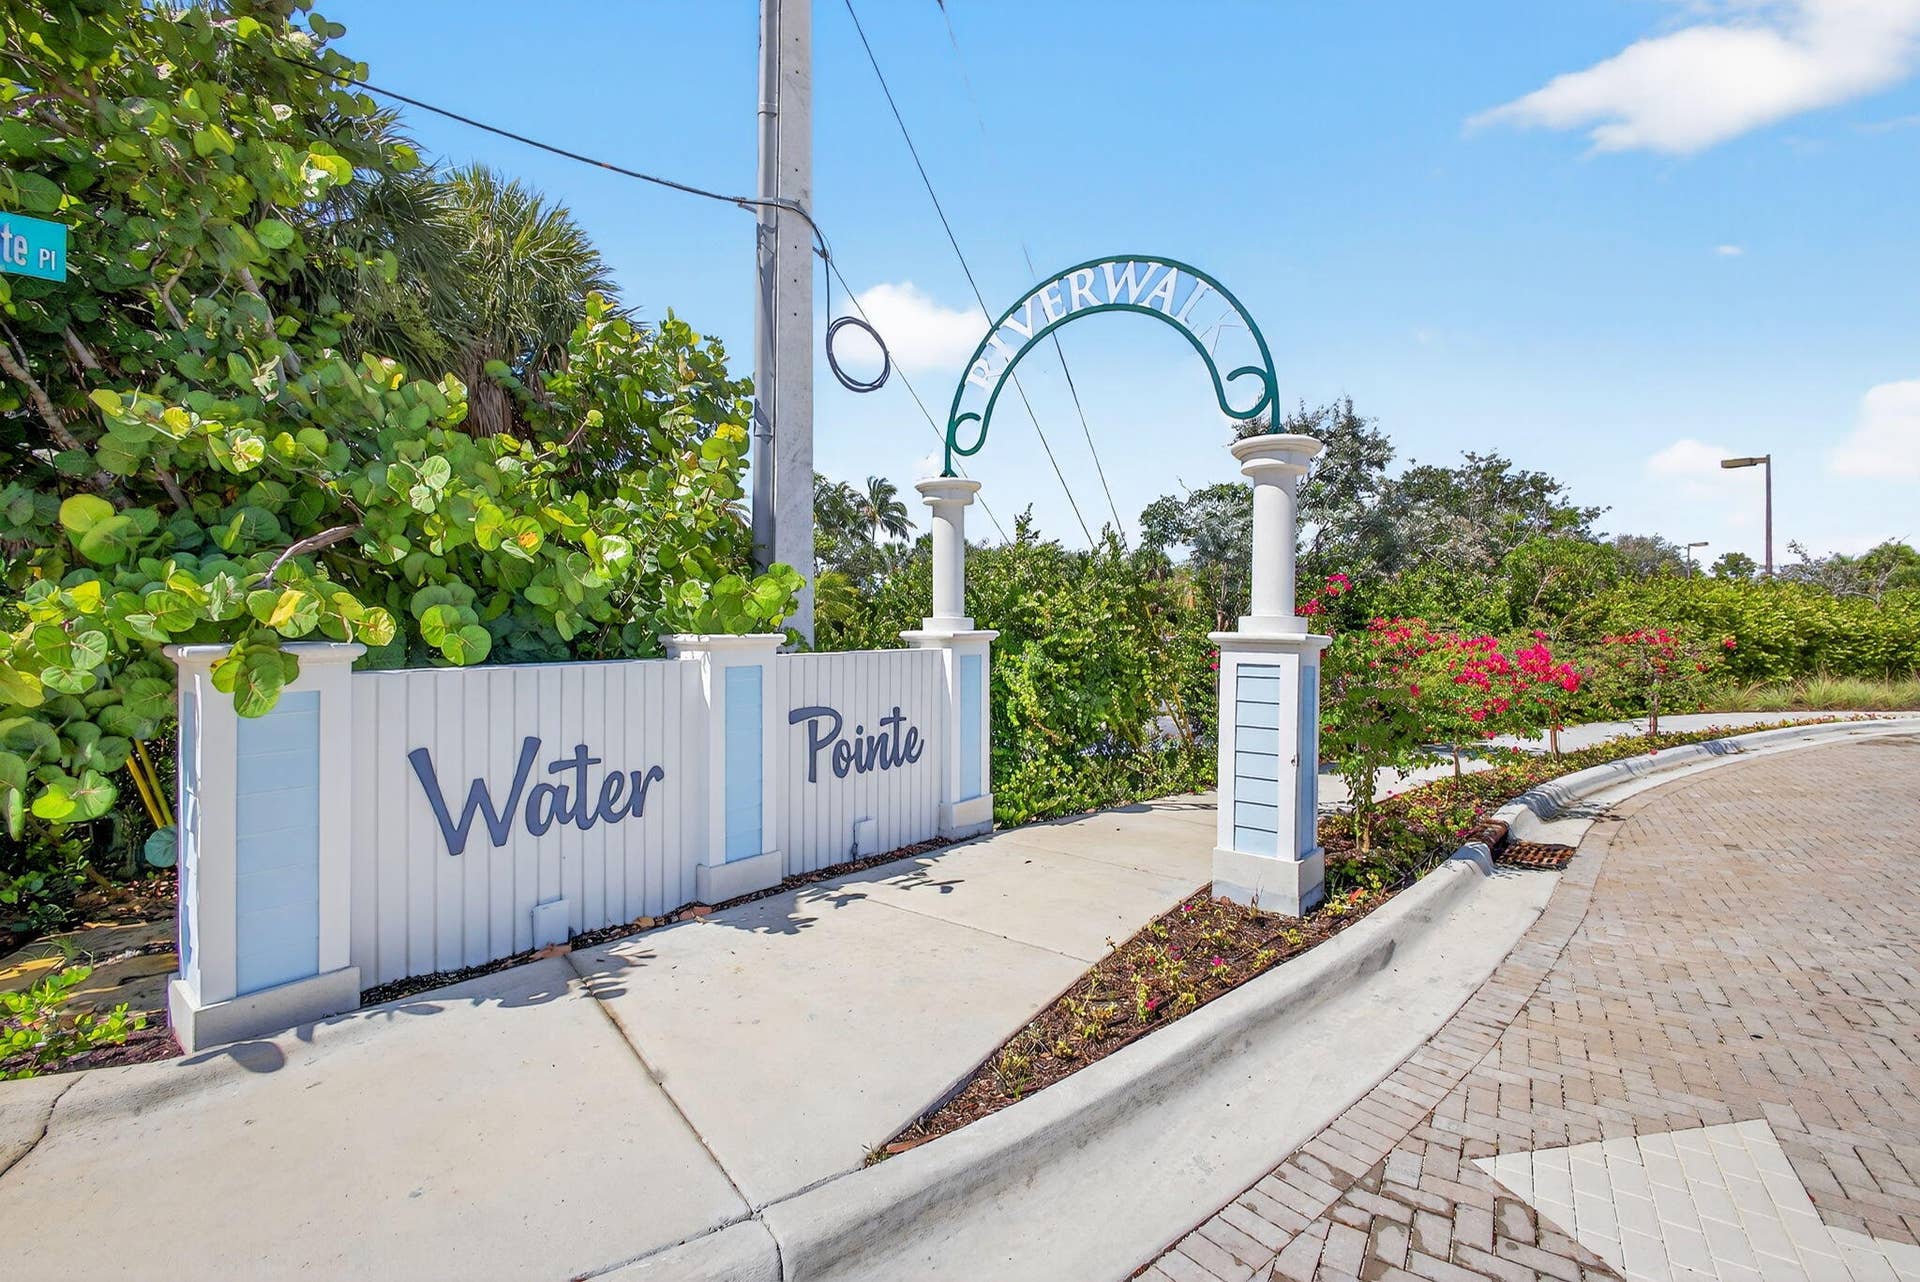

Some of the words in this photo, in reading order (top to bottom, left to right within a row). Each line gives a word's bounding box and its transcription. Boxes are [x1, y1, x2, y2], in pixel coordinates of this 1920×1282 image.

[39, 248, 56, 271] Pl
[964, 260, 1250, 390] RIVERWALK
[408, 737, 664, 856] Water
[788, 706, 924, 783] Pointe
